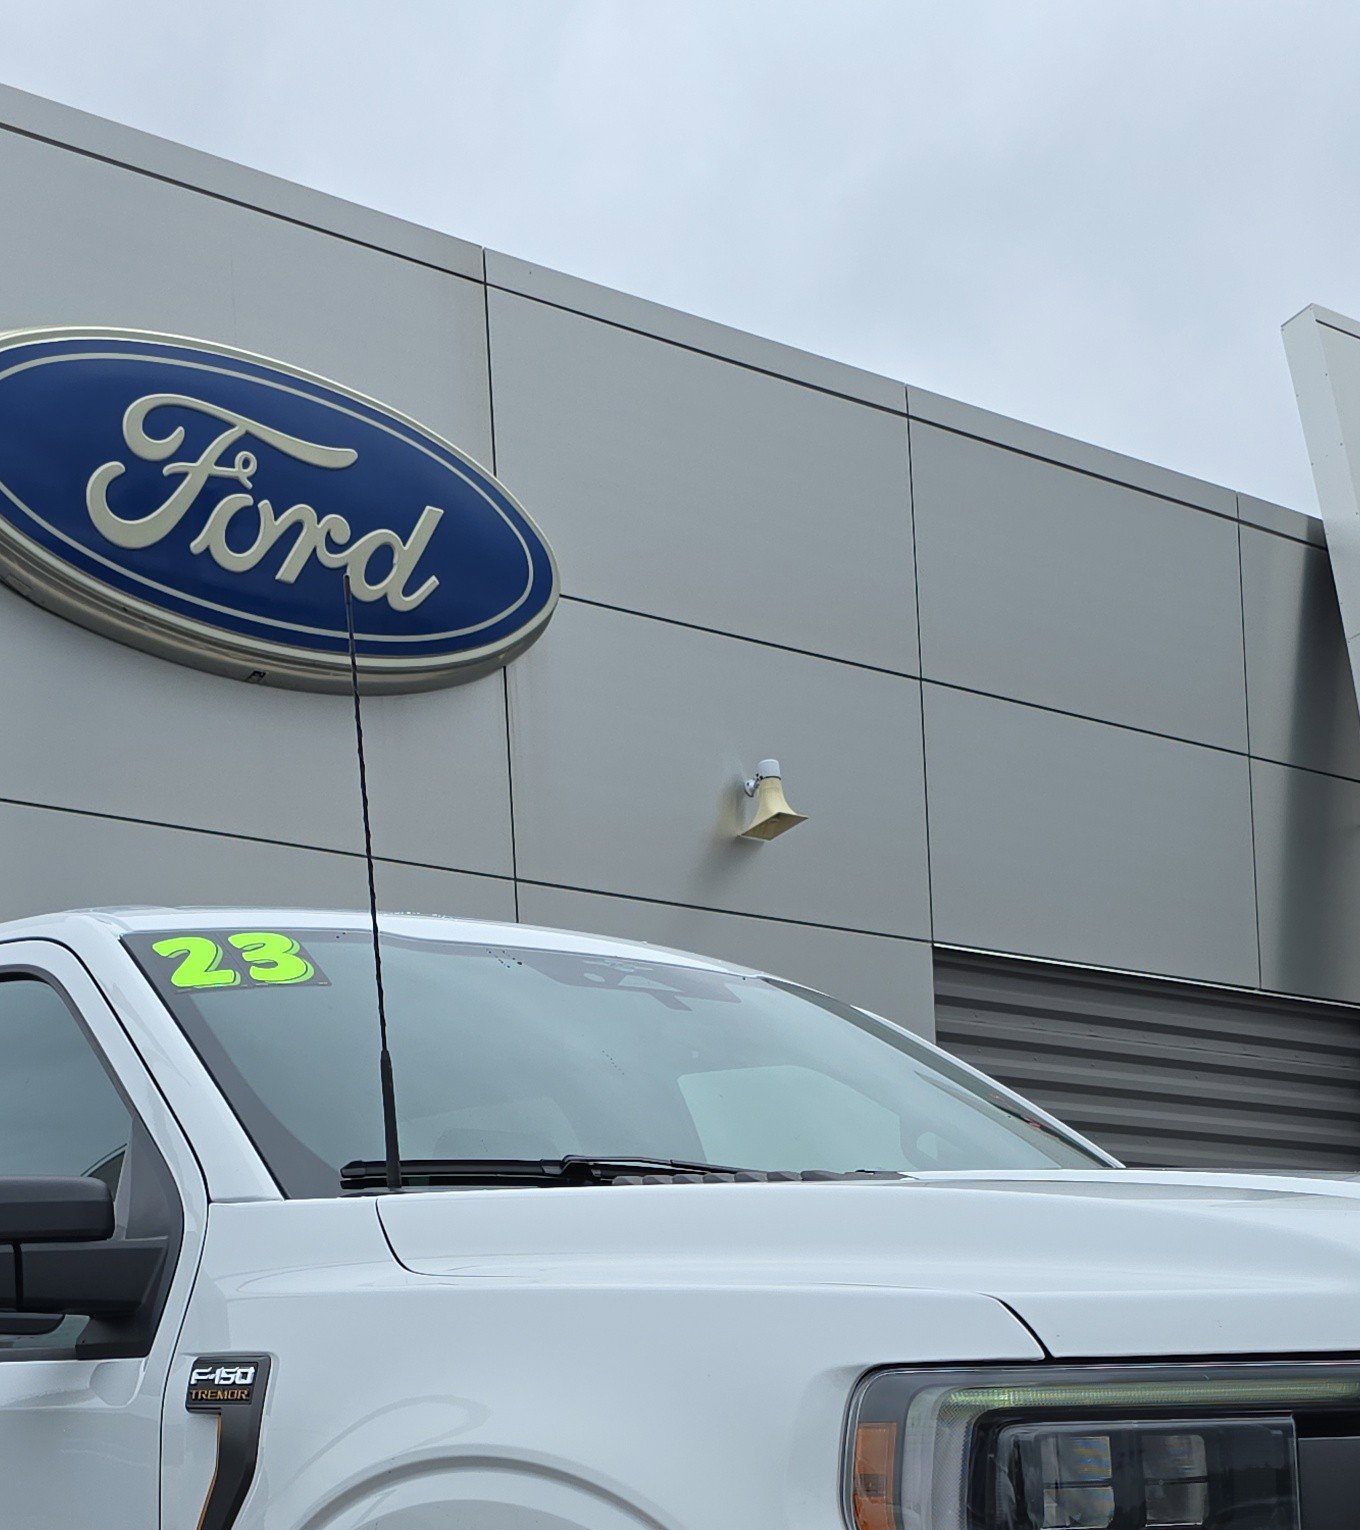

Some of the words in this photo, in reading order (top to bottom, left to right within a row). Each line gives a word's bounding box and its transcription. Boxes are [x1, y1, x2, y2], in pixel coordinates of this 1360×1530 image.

[86, 393, 444, 612] Ford
[152, 932, 315, 988] 23
[189, 1366, 256, 1385] F-150
[189, 1389, 249, 1400] TREMOR
